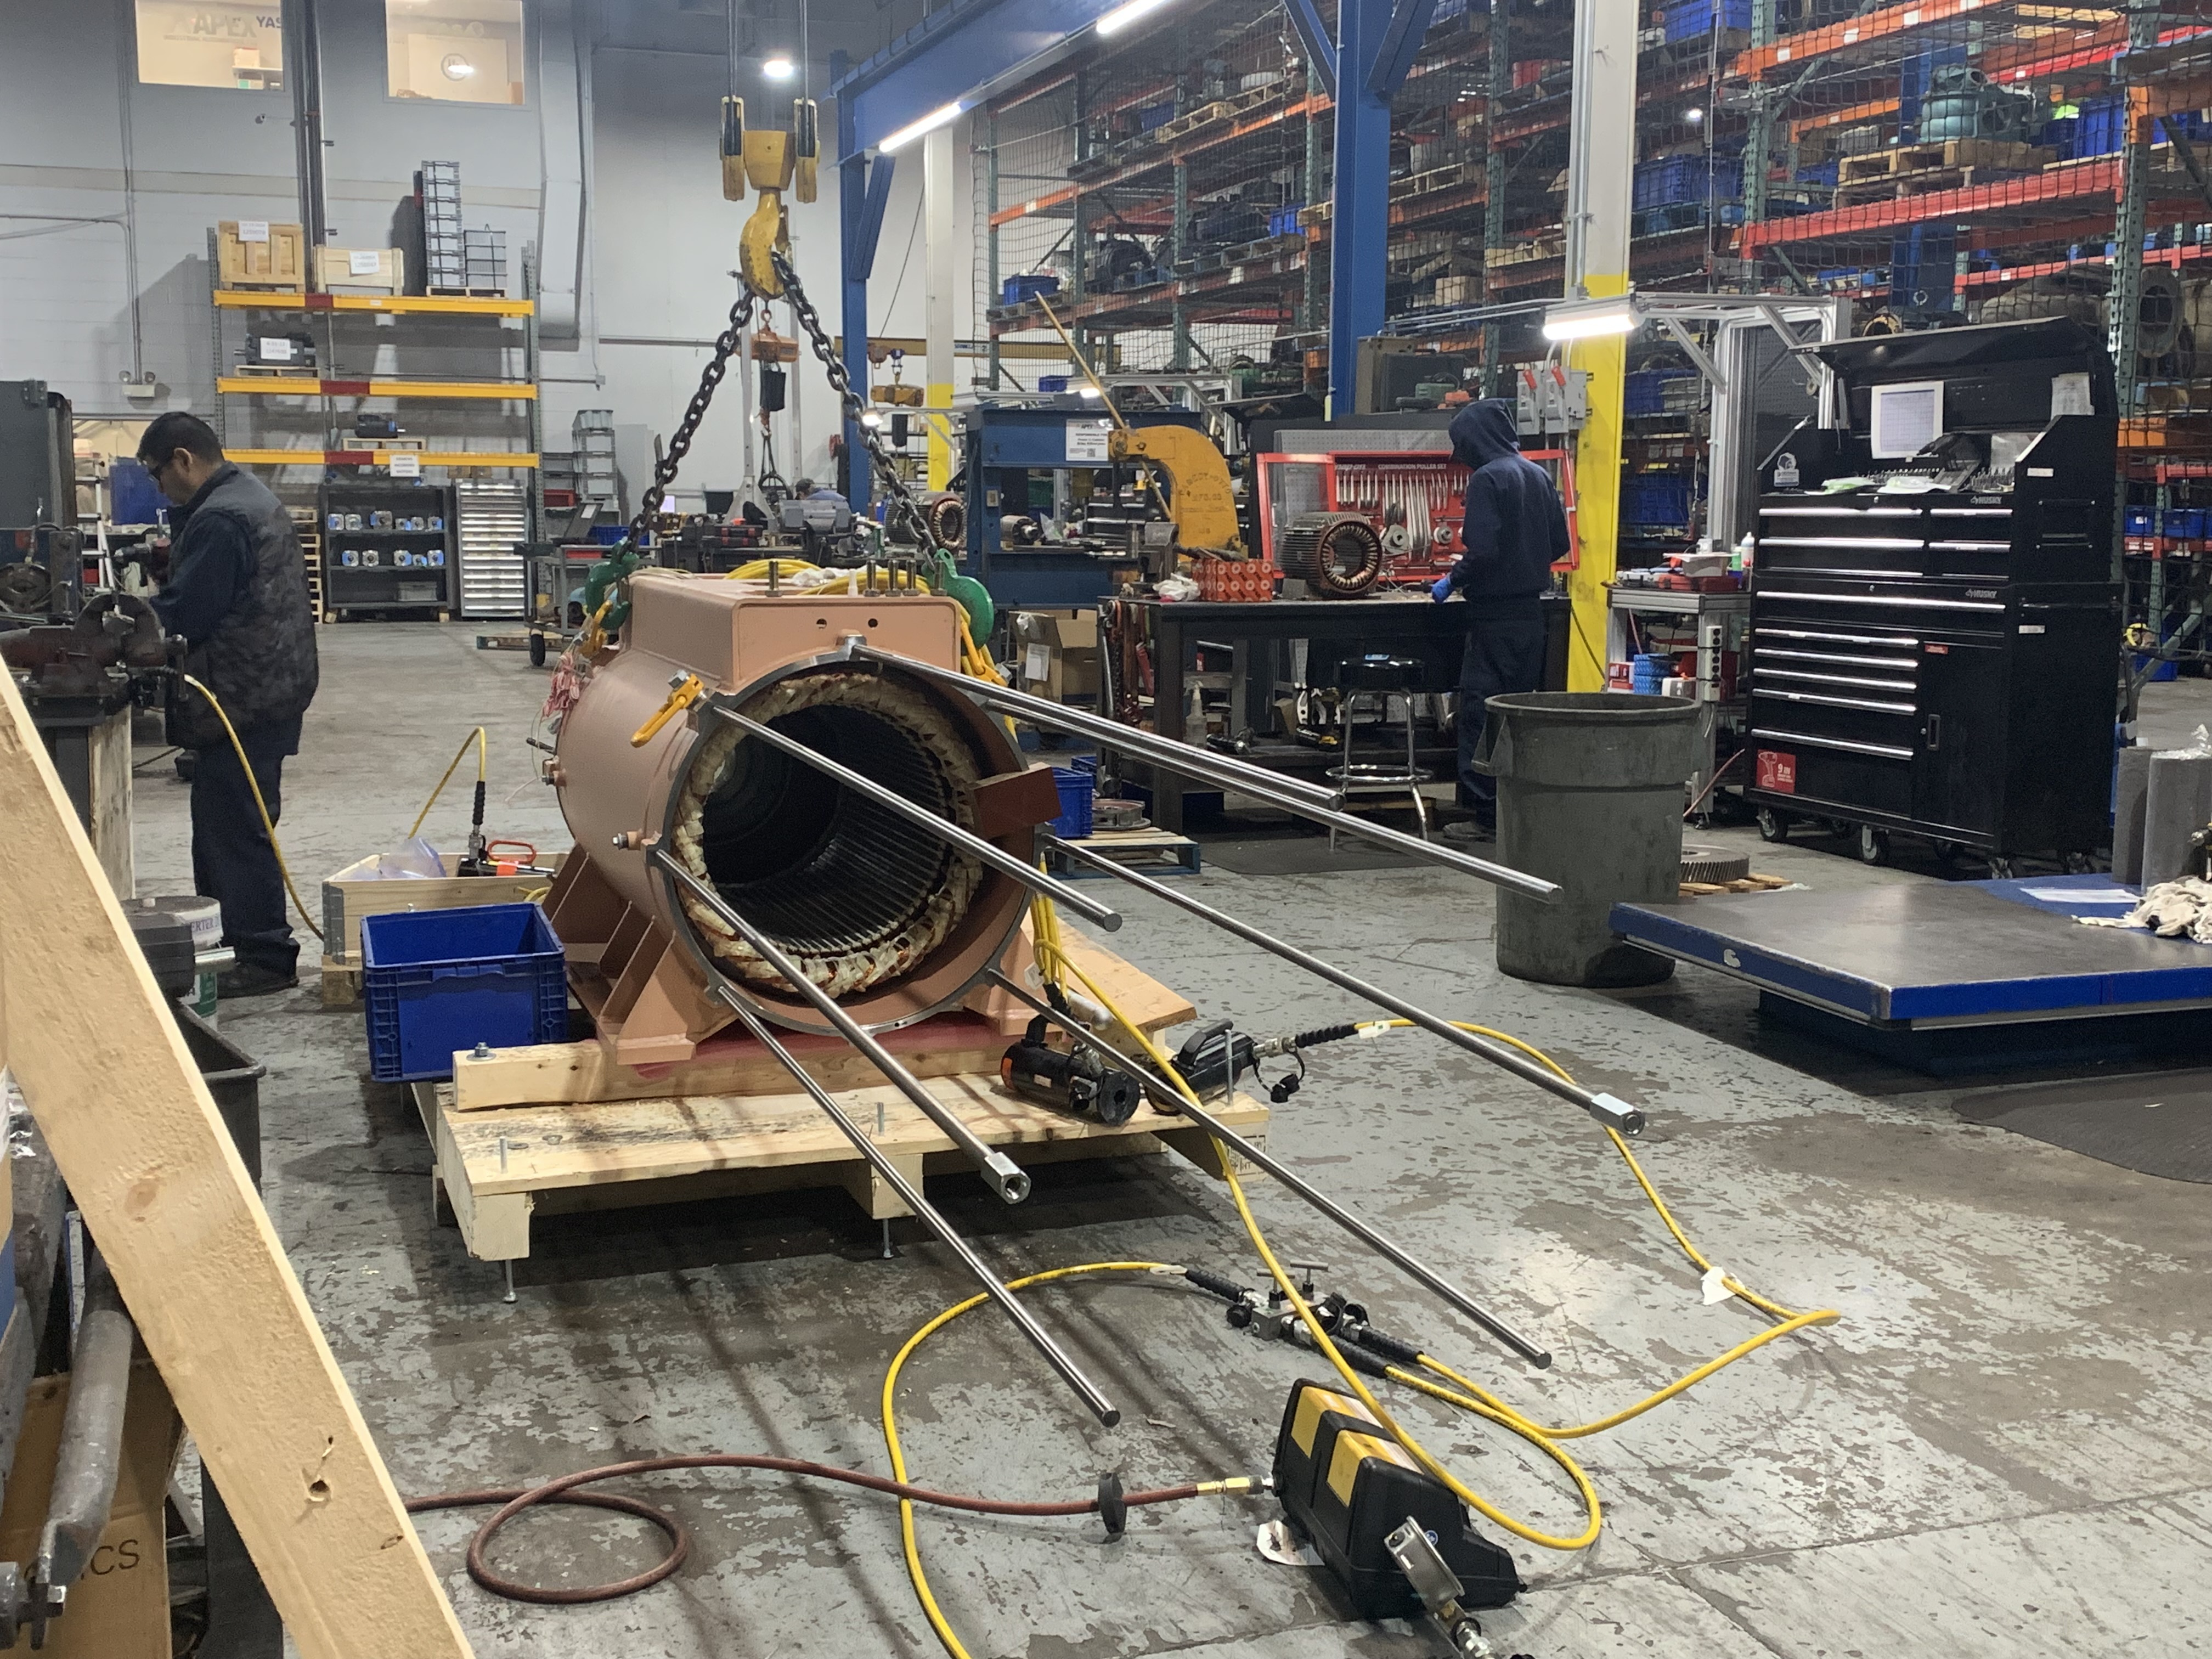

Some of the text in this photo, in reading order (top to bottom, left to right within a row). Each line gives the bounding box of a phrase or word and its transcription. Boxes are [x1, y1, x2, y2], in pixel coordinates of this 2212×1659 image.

[1978, 496, 2002, 504] HUSKY
[1973, 590, 1997, 599] HUSKY
[1778, 763, 1783, 773] 9
[80, 1539, 140, 1580] CS
